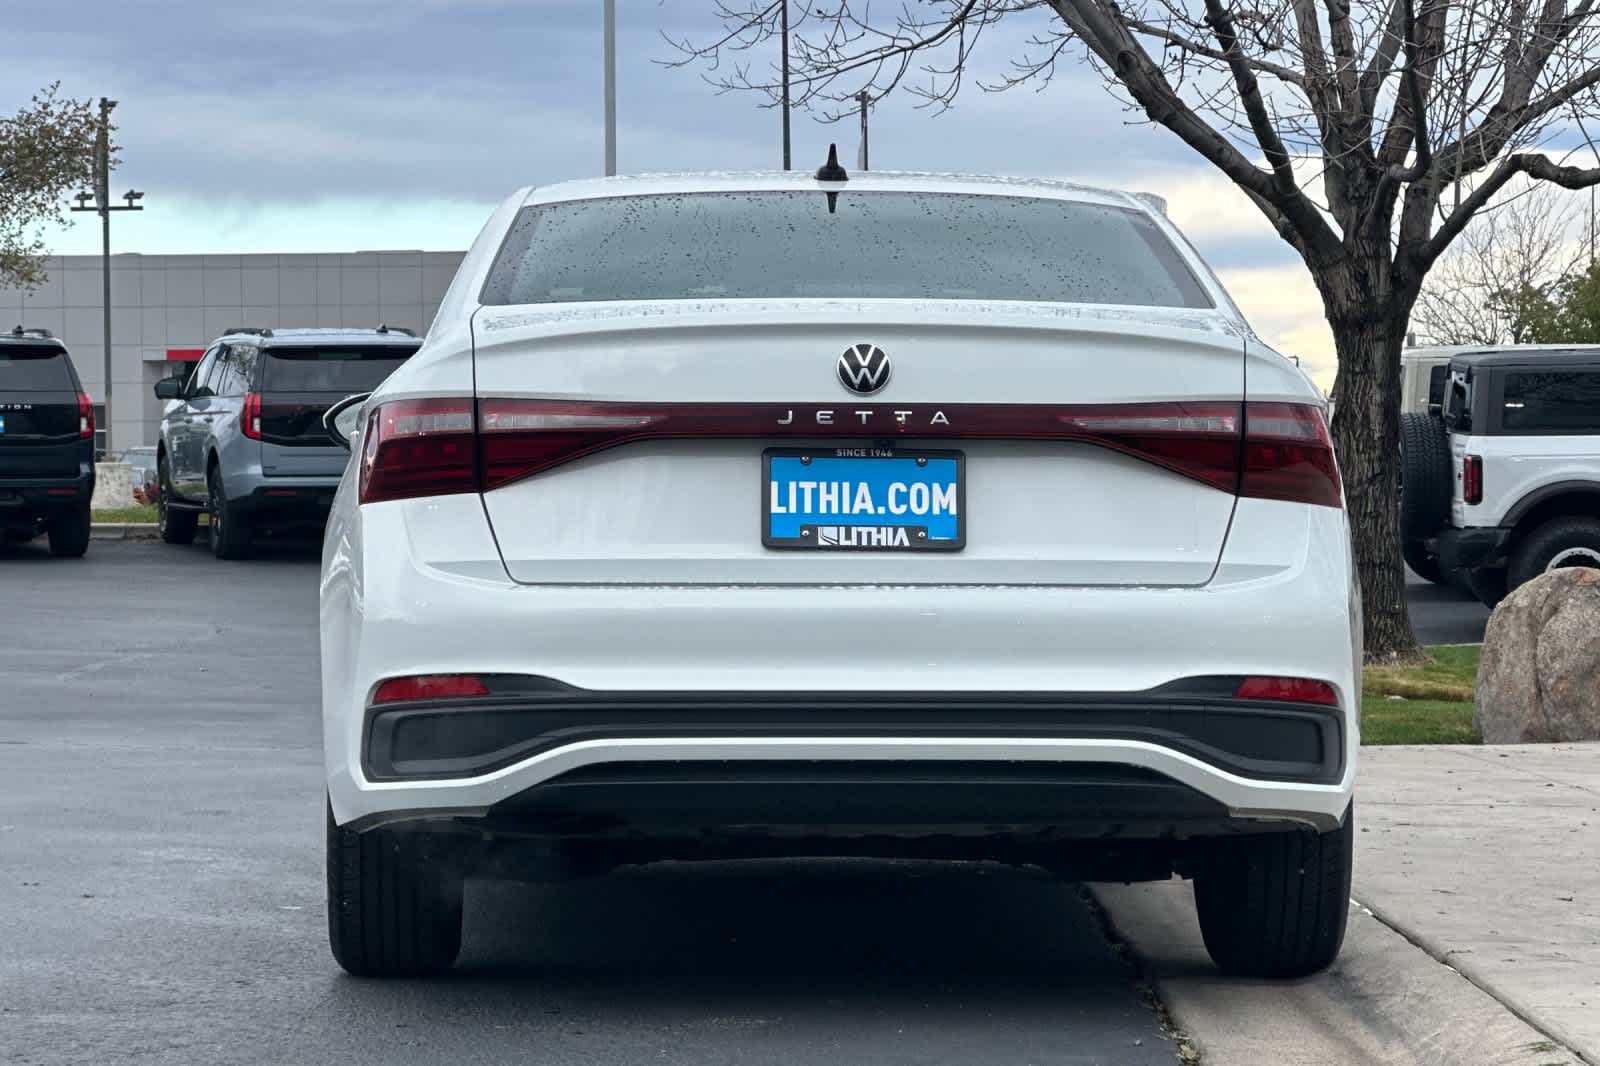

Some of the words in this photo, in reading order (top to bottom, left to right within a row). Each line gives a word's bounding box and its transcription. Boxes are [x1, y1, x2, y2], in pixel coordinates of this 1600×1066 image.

[838, 344, 891, 393] VW
[777, 410, 949, 425] JETTA
[837, 449, 866, 457] SINCE
[871, 449, 892, 457] 1946
[770, 480, 957, 515] LITHIA.COM
[839, 526, 910, 546] LITHIA
